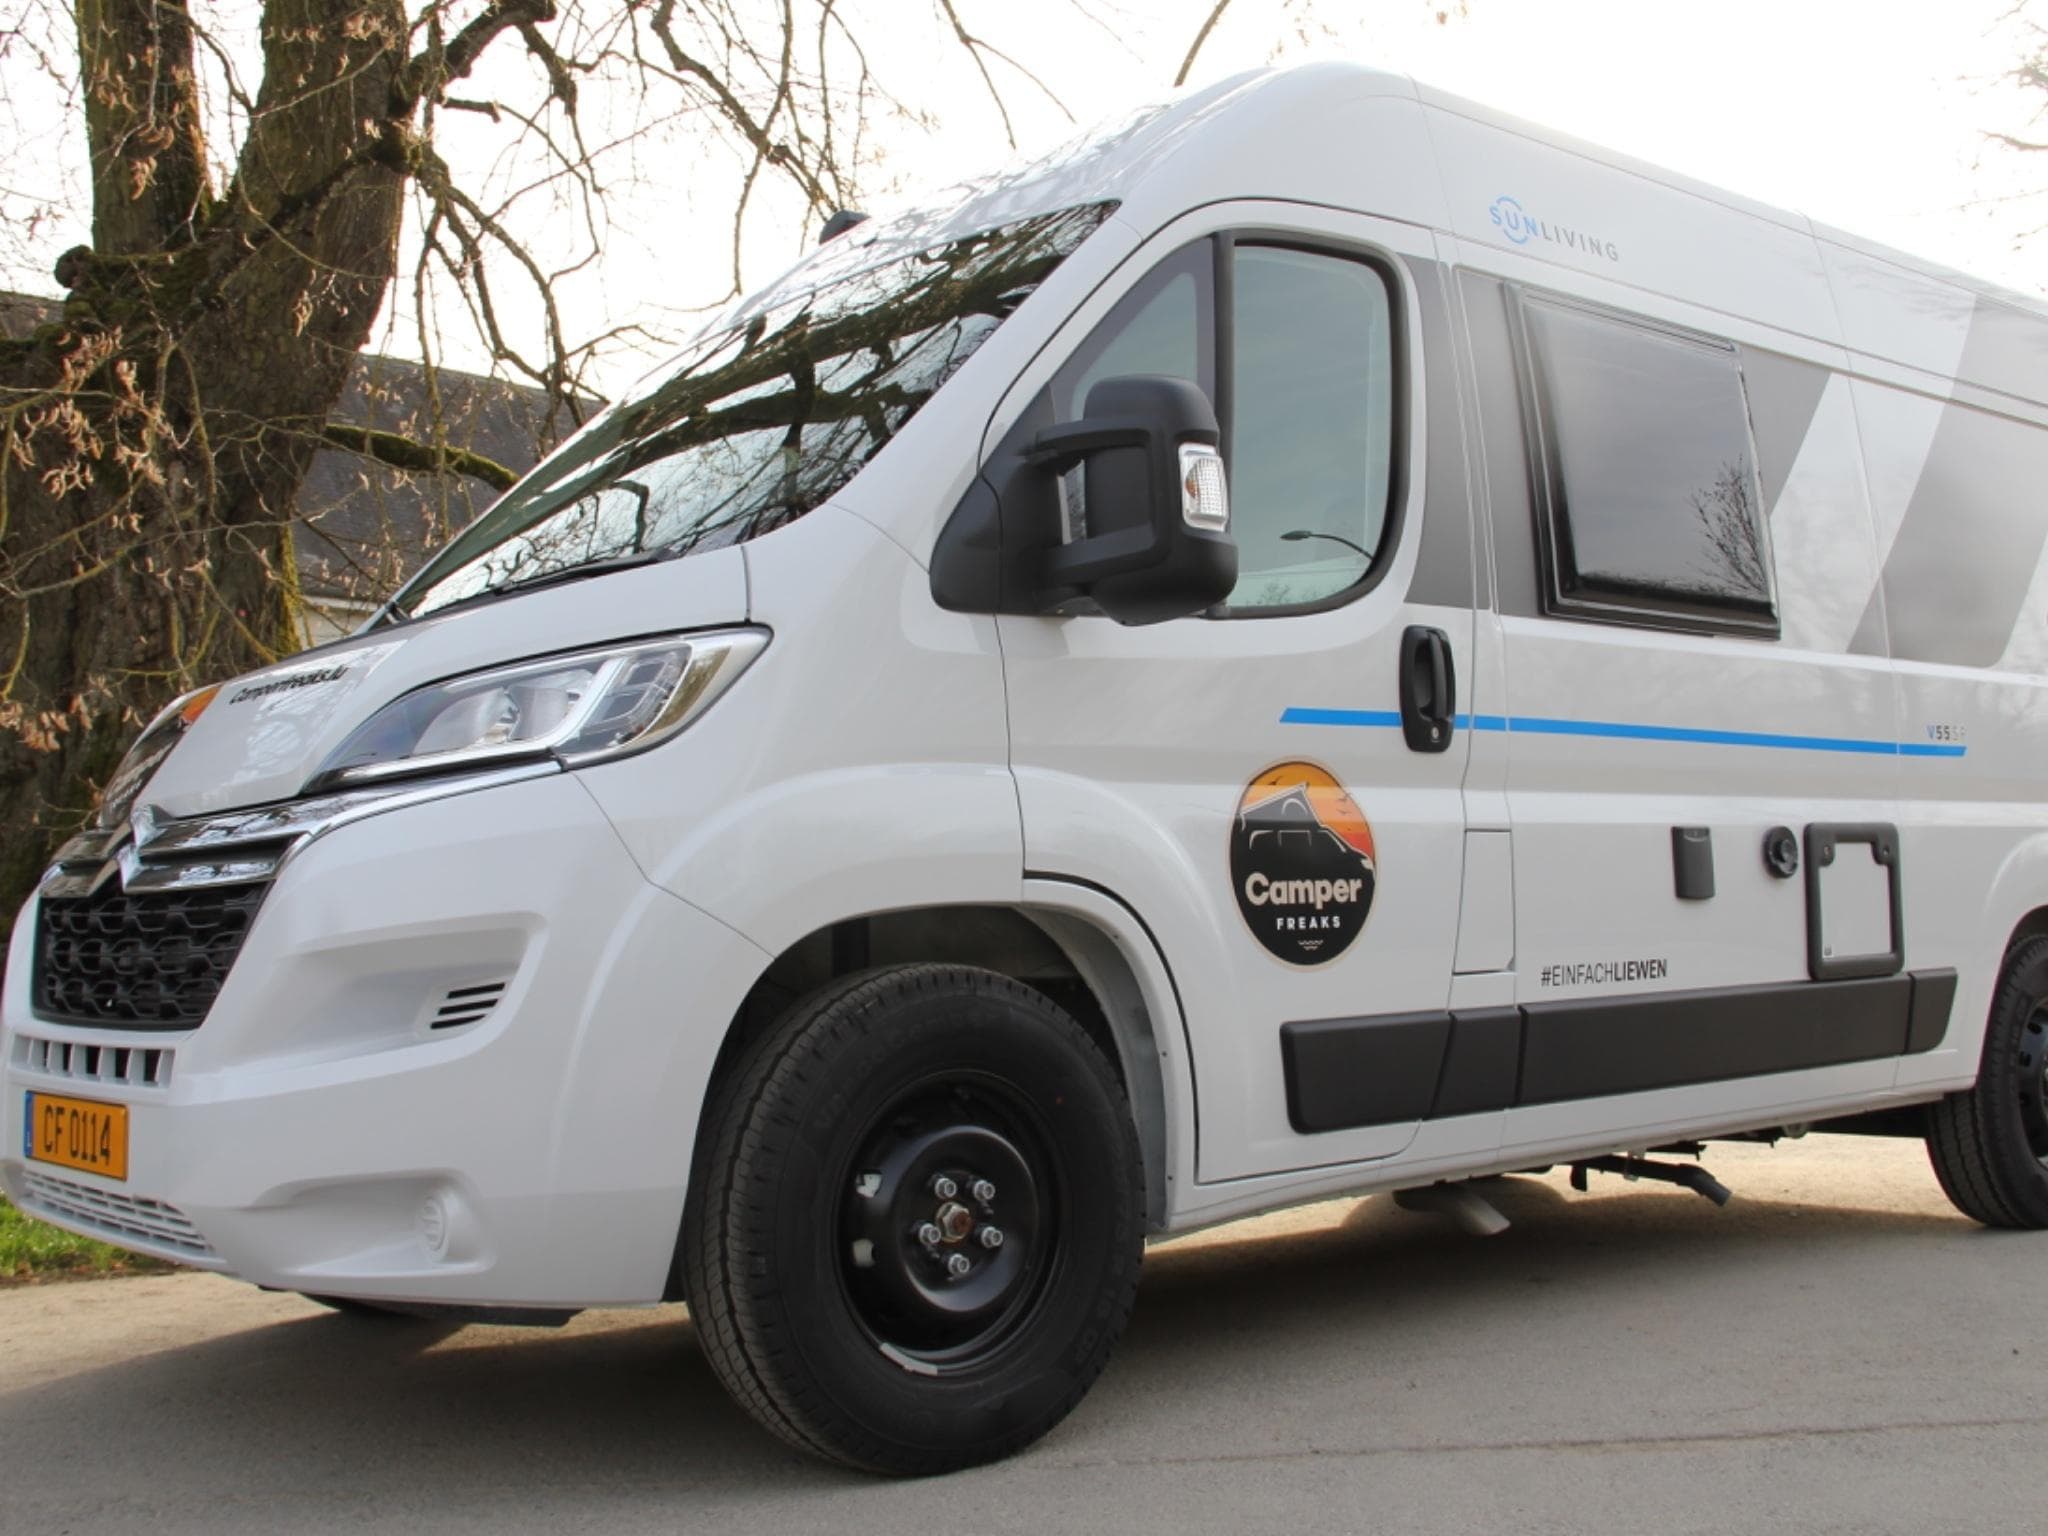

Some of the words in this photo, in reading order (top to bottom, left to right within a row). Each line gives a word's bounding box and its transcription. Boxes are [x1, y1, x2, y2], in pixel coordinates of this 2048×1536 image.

[1489, 196, 1619, 262] SUNLIVING
[1245, 872, 1362, 909] Camper
[1276, 915, 1341, 931] FREAKS
[1541, 958, 1668, 987] #EINFACHLIEWEN
[44, 1104, 65, 1155] CF
[70, 1108, 111, 1166] 0114
